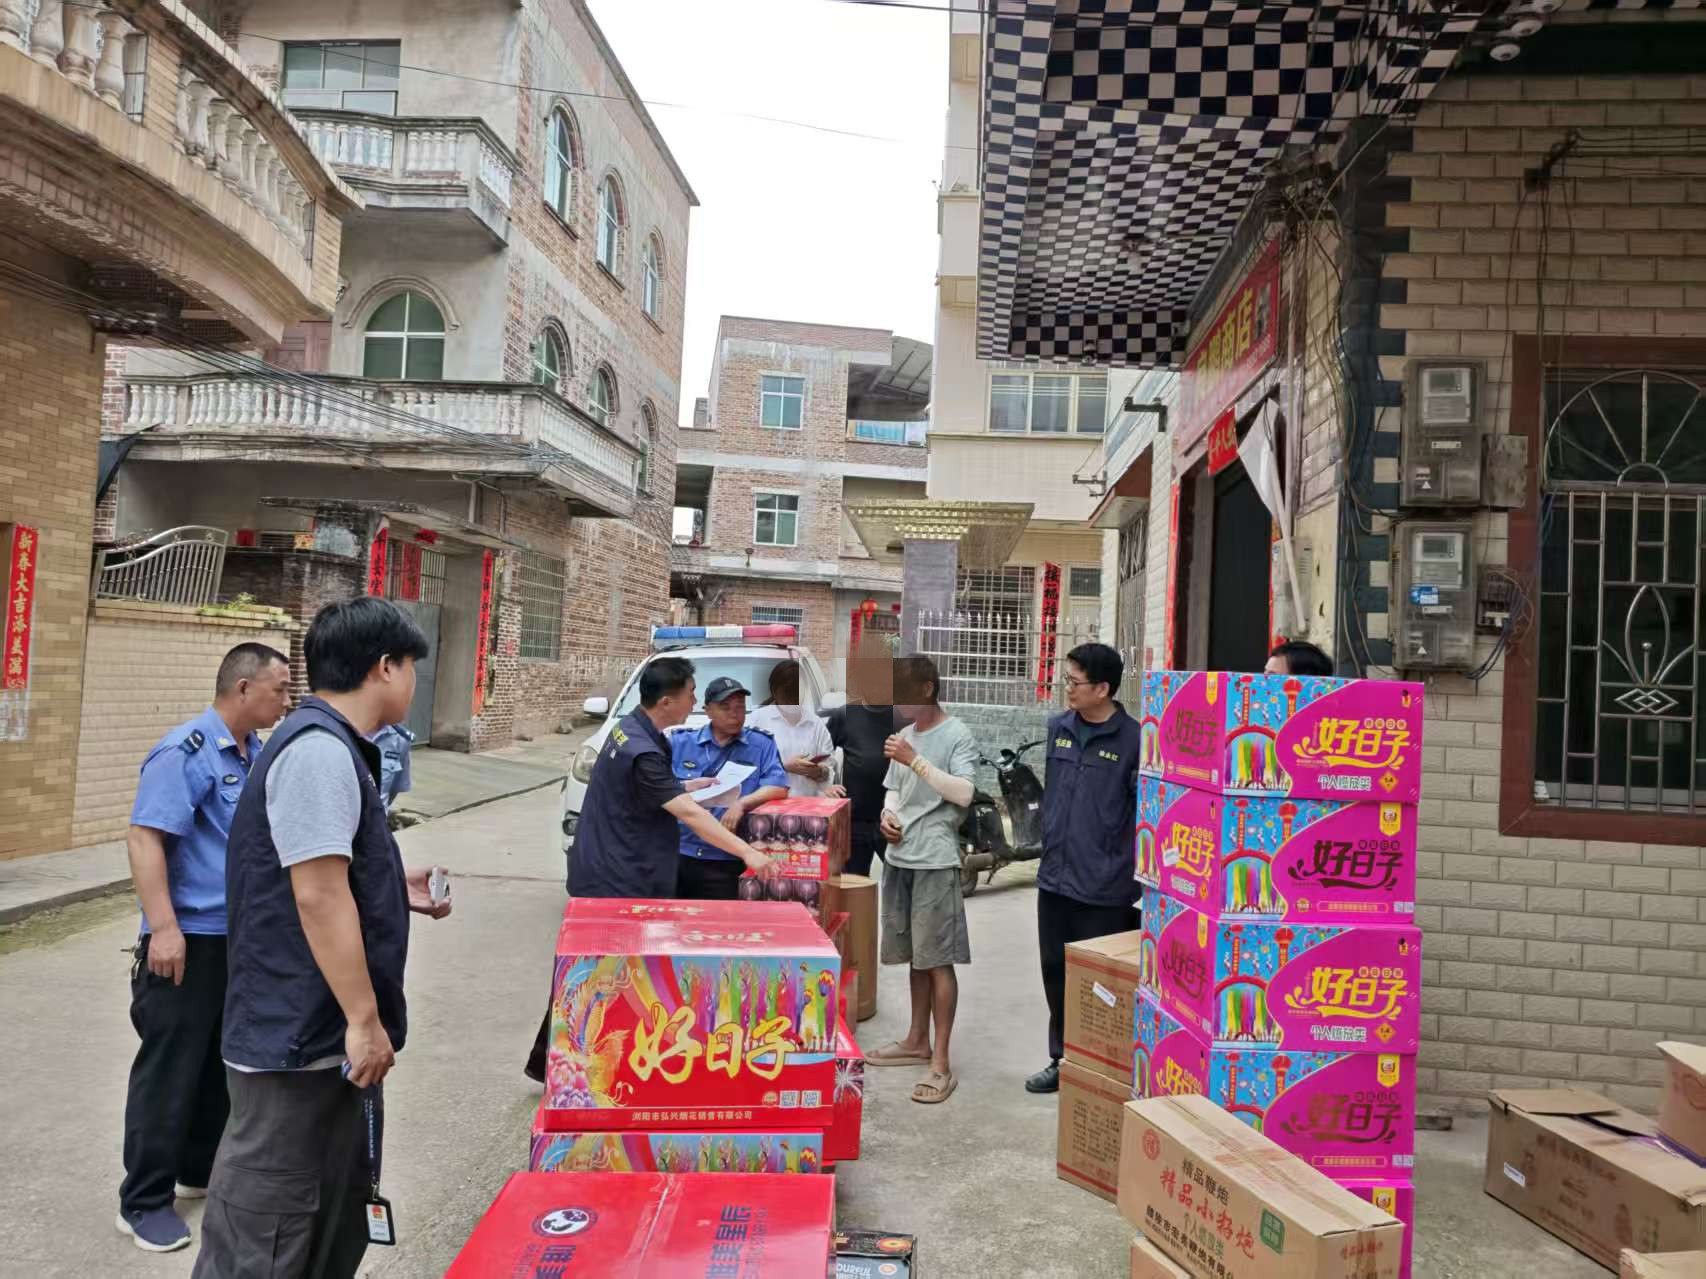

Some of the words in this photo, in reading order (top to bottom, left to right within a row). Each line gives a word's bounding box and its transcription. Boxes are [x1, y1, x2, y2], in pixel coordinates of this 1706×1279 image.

[1293, 717, 1410, 770] 好日子
[1161, 822, 1215, 881] 好日子
[1288, 839, 1403, 891] 好日子
[1284, 966, 1408, 1020] 好日子
[627, 1002, 796, 1084] 好日子
[1281, 1092, 1402, 1144] 好日子
